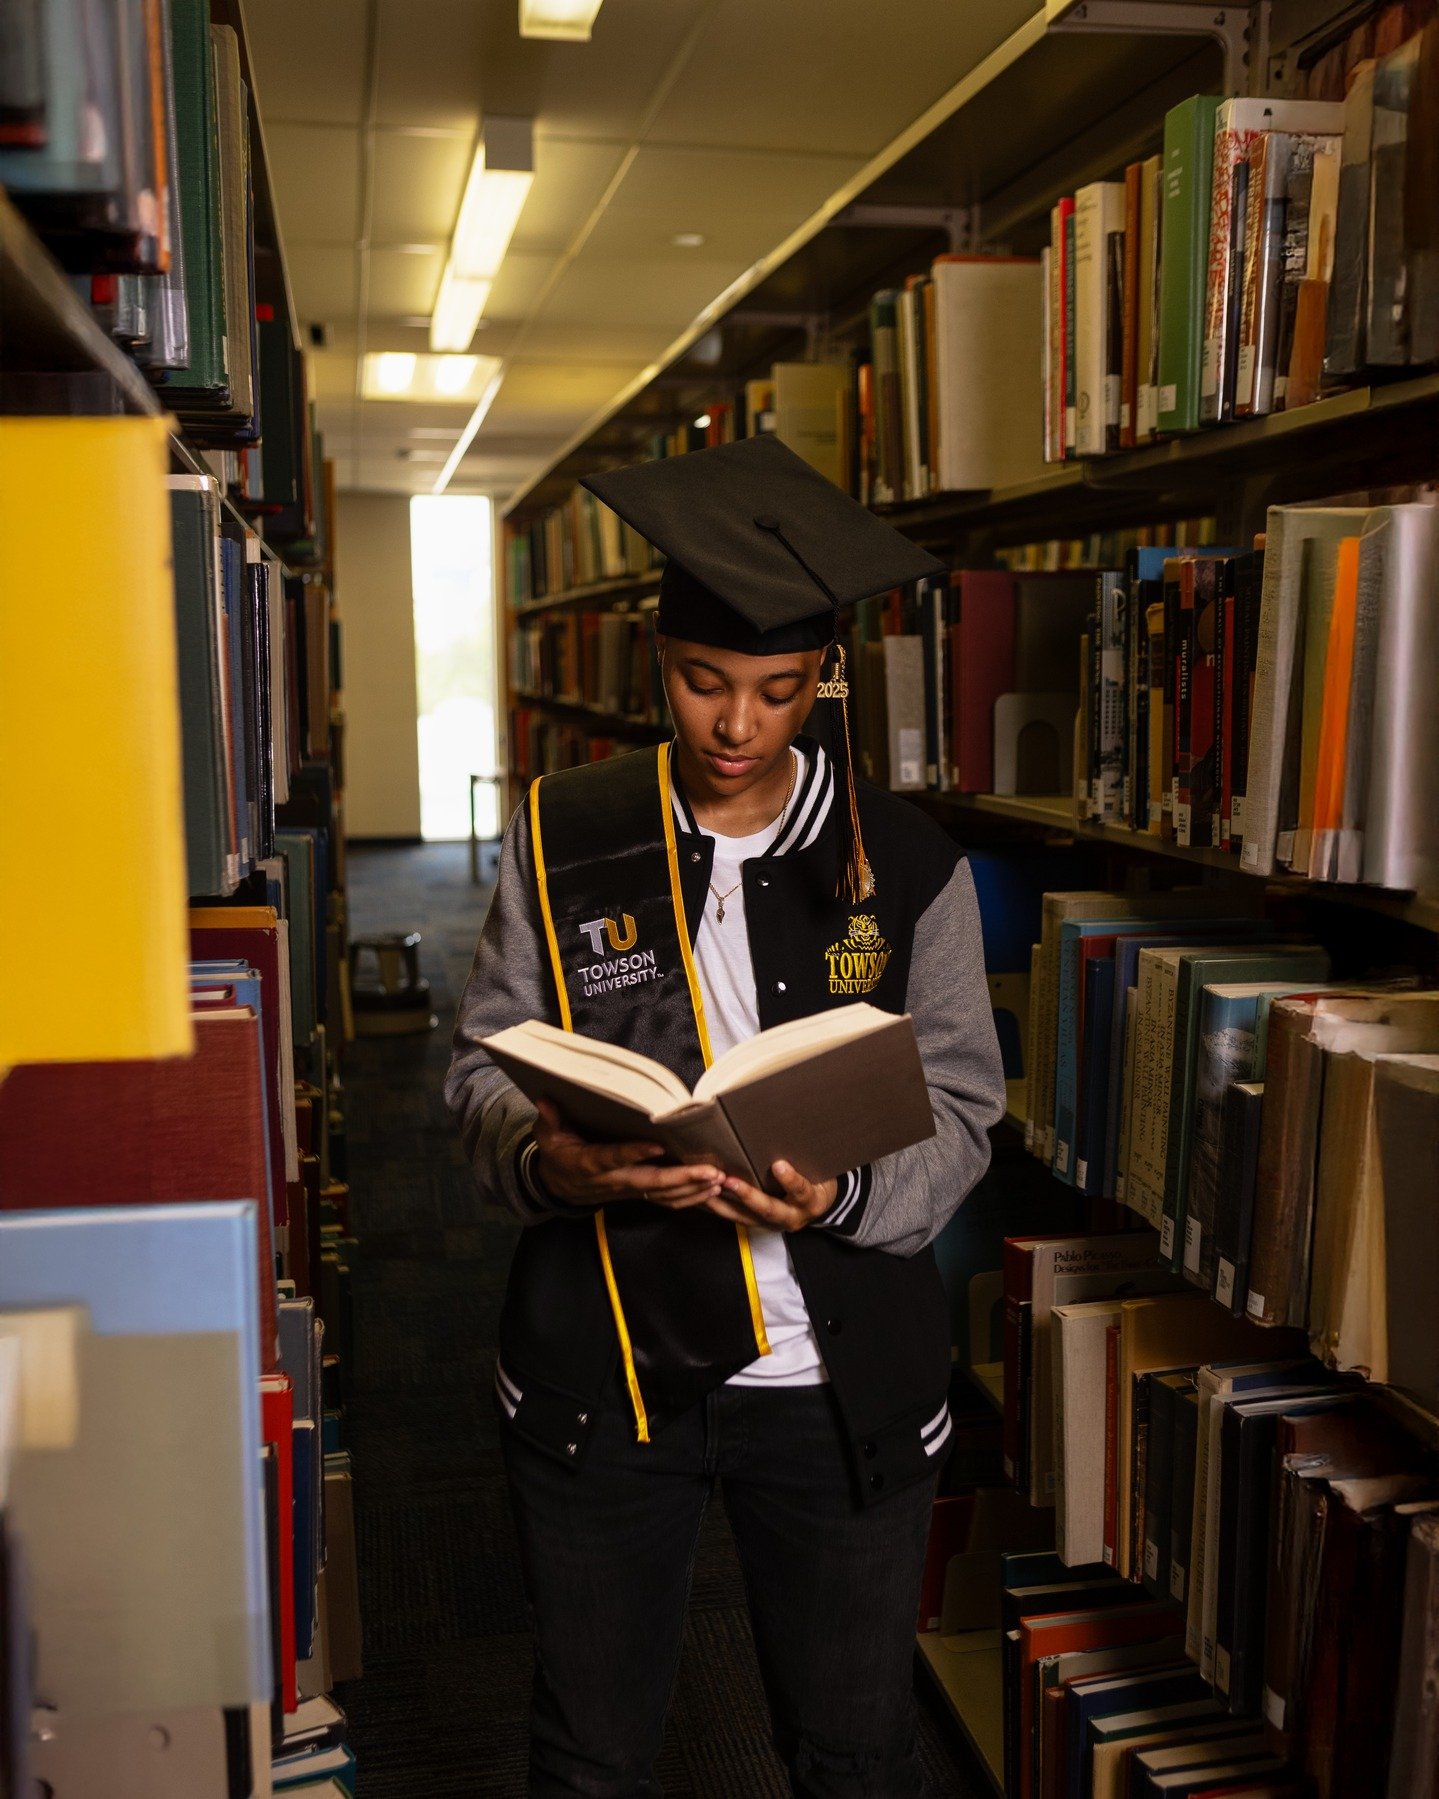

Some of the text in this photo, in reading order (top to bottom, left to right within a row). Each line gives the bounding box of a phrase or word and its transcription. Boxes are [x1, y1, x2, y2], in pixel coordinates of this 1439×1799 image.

[817, 681, 849, 698] 2025
[579, 912, 638, 957] TU
[577, 949, 656, 983] TOWSON
[1137, 1011, 1144, 1026] IN
[1143, 976, 1152, 1046] BYZANTINE
[1151, 1019, 1157, 1034] IN
[1165, 987, 1175, 1060] BYZANTINE
[1160, 1025, 1166, 1039] IN
[1155, 1074, 1163, 1115] MINOR
[1163, 1065, 1171, 1096] WALL
[1139, 1084, 1148, 1141] PAINTING
[1160, 1100, 1169, 1160] PAINTING
[1054, 1250, 1081, 1262] Pablo
[1196, 1437, 1209, 1594] MEDIEVAL MINIATURES
